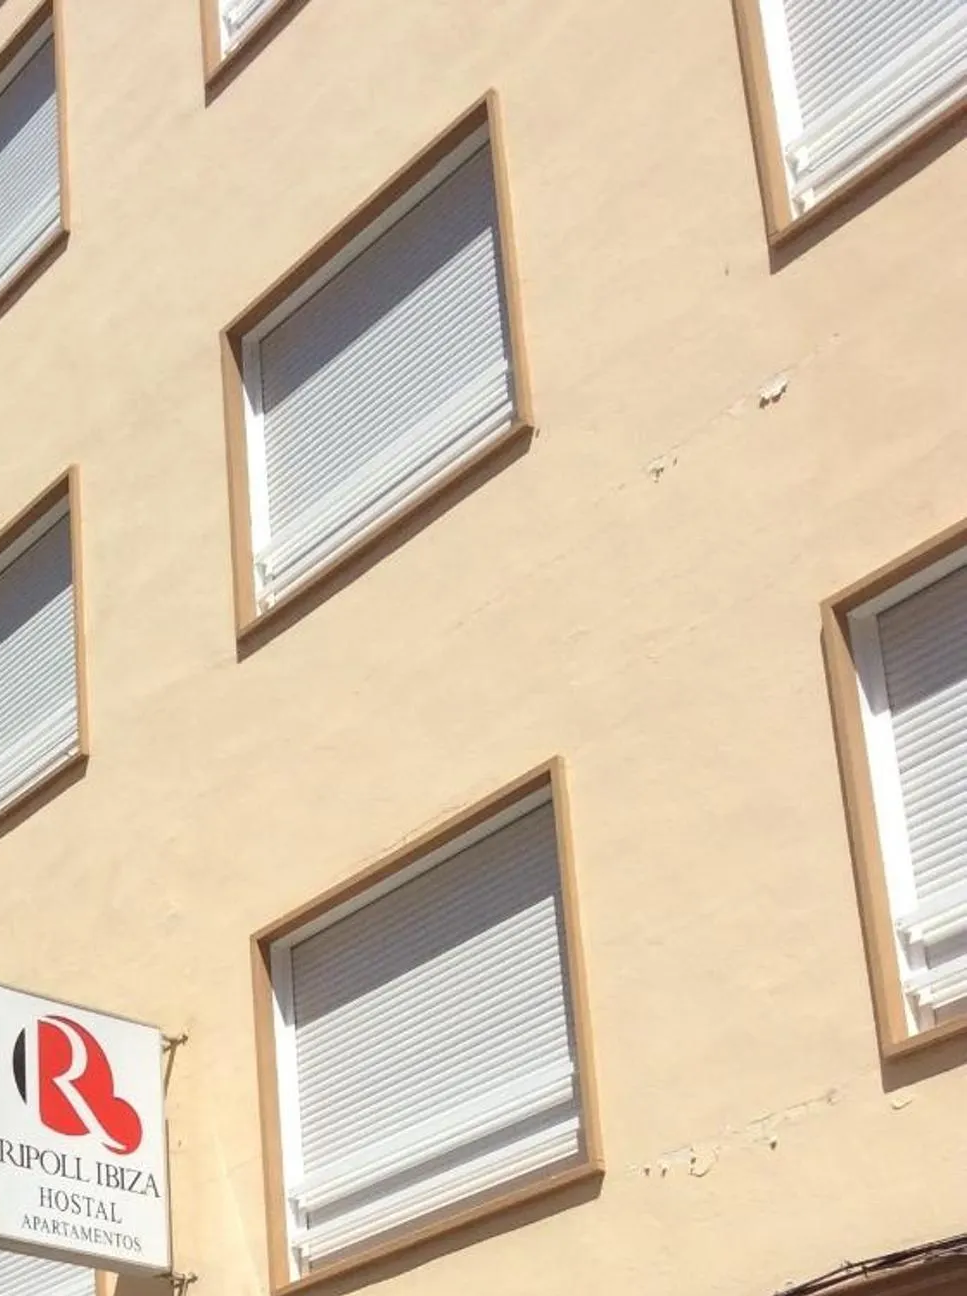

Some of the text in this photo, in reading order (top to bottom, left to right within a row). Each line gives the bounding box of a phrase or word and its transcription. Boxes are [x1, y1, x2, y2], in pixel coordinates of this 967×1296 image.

[95, 1160, 161, 1198] IBIZA
[39, 1187, 123, 1224] HOSTAL
[21, 1214, 142, 1252] APARTAMENTOS
